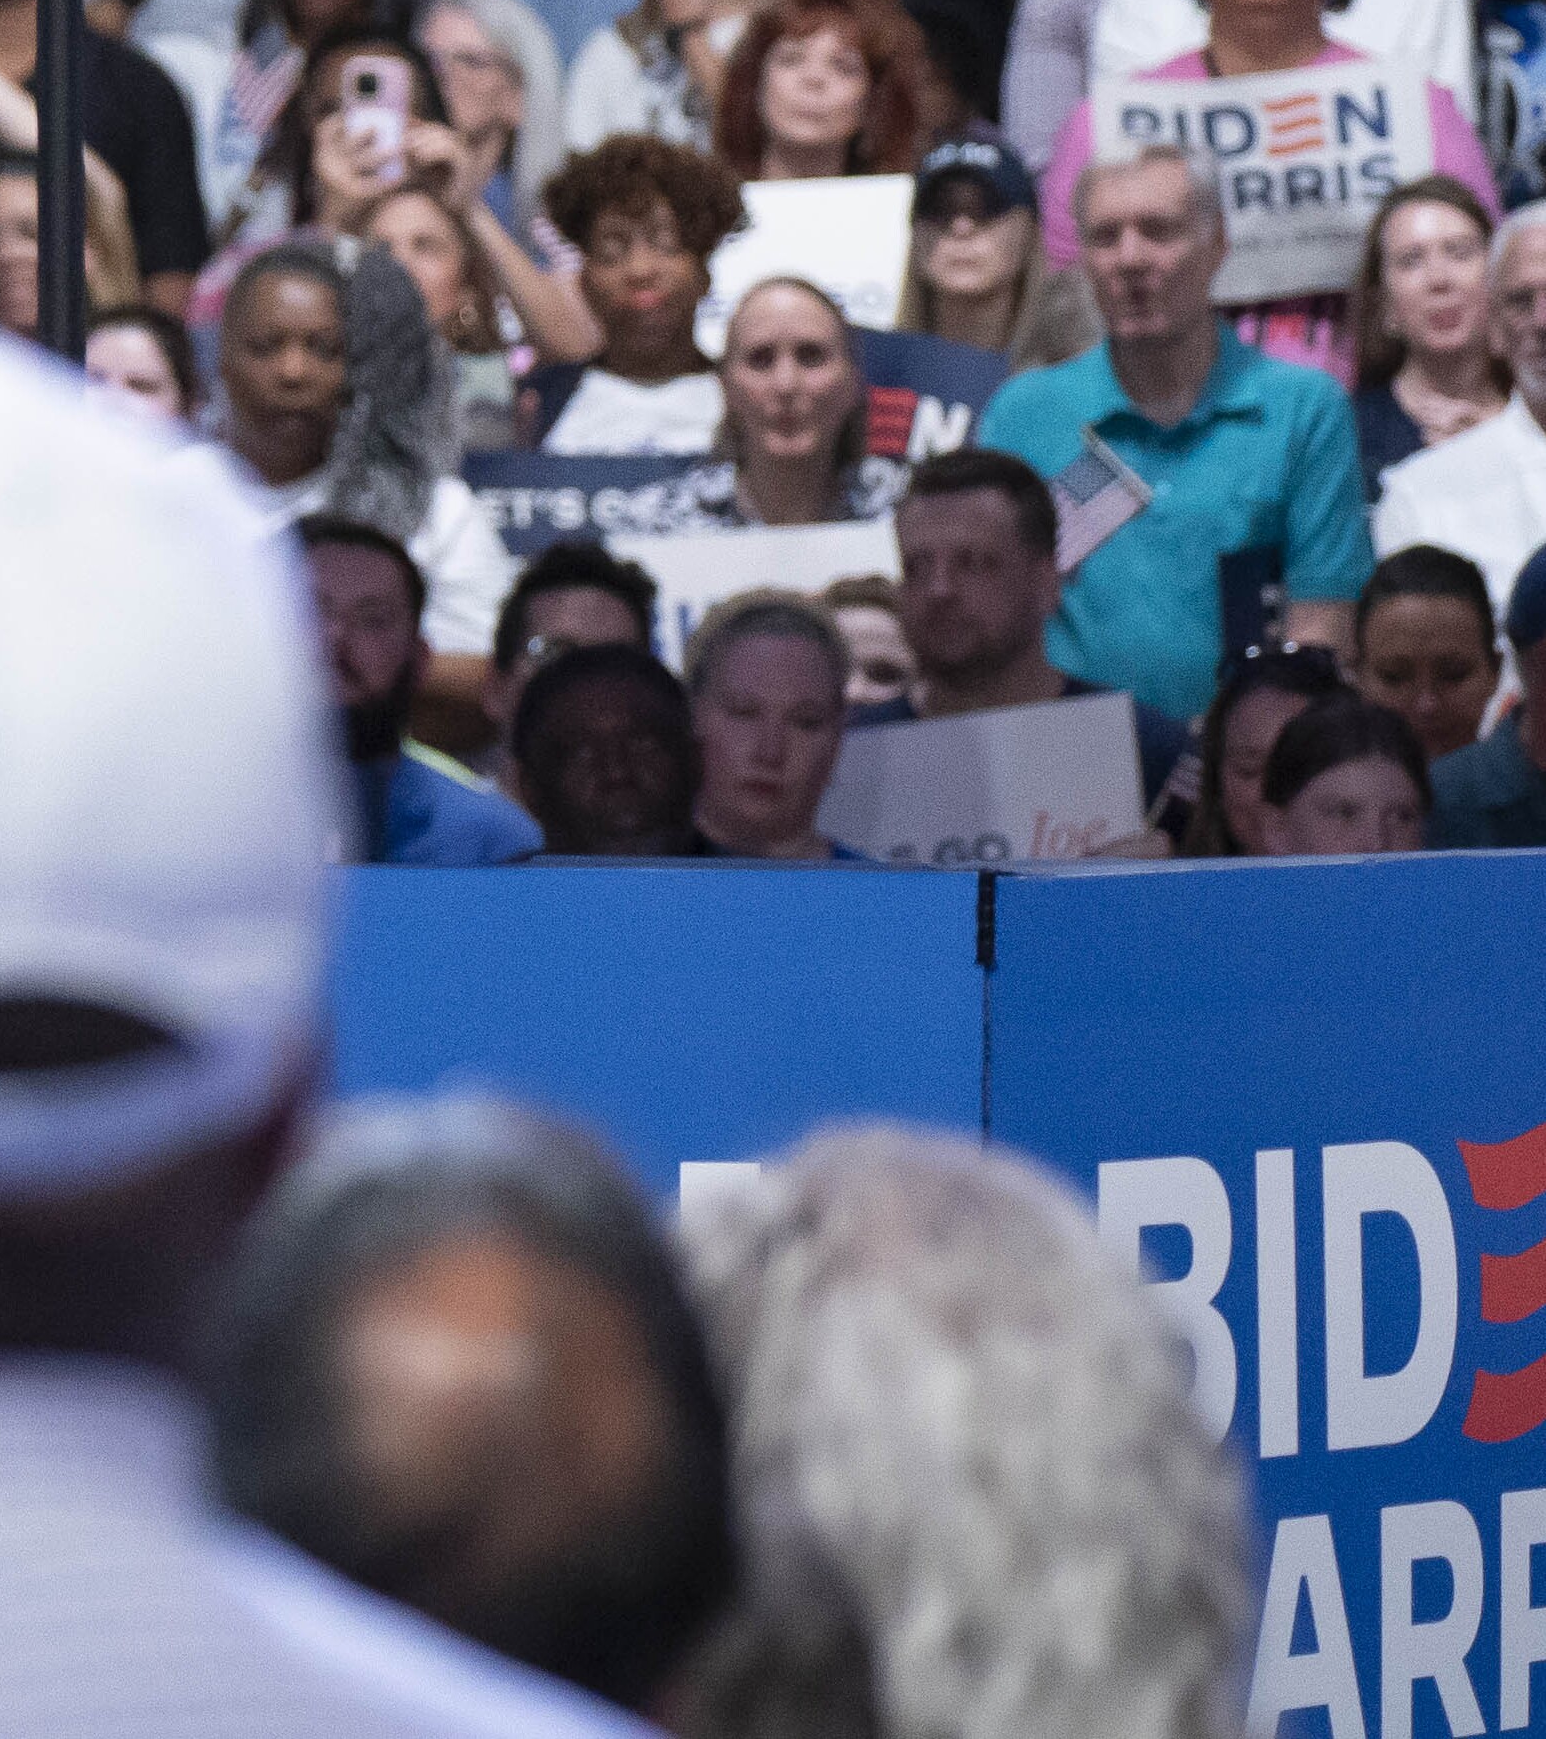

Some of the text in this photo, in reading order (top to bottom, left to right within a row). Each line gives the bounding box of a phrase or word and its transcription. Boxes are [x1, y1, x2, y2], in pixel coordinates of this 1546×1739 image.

[1120, 86, 1389, 159] BIDEN
[1232, 154, 1399, 210] RRIS
[1097, 1122, 1546, 1458] BIDE
